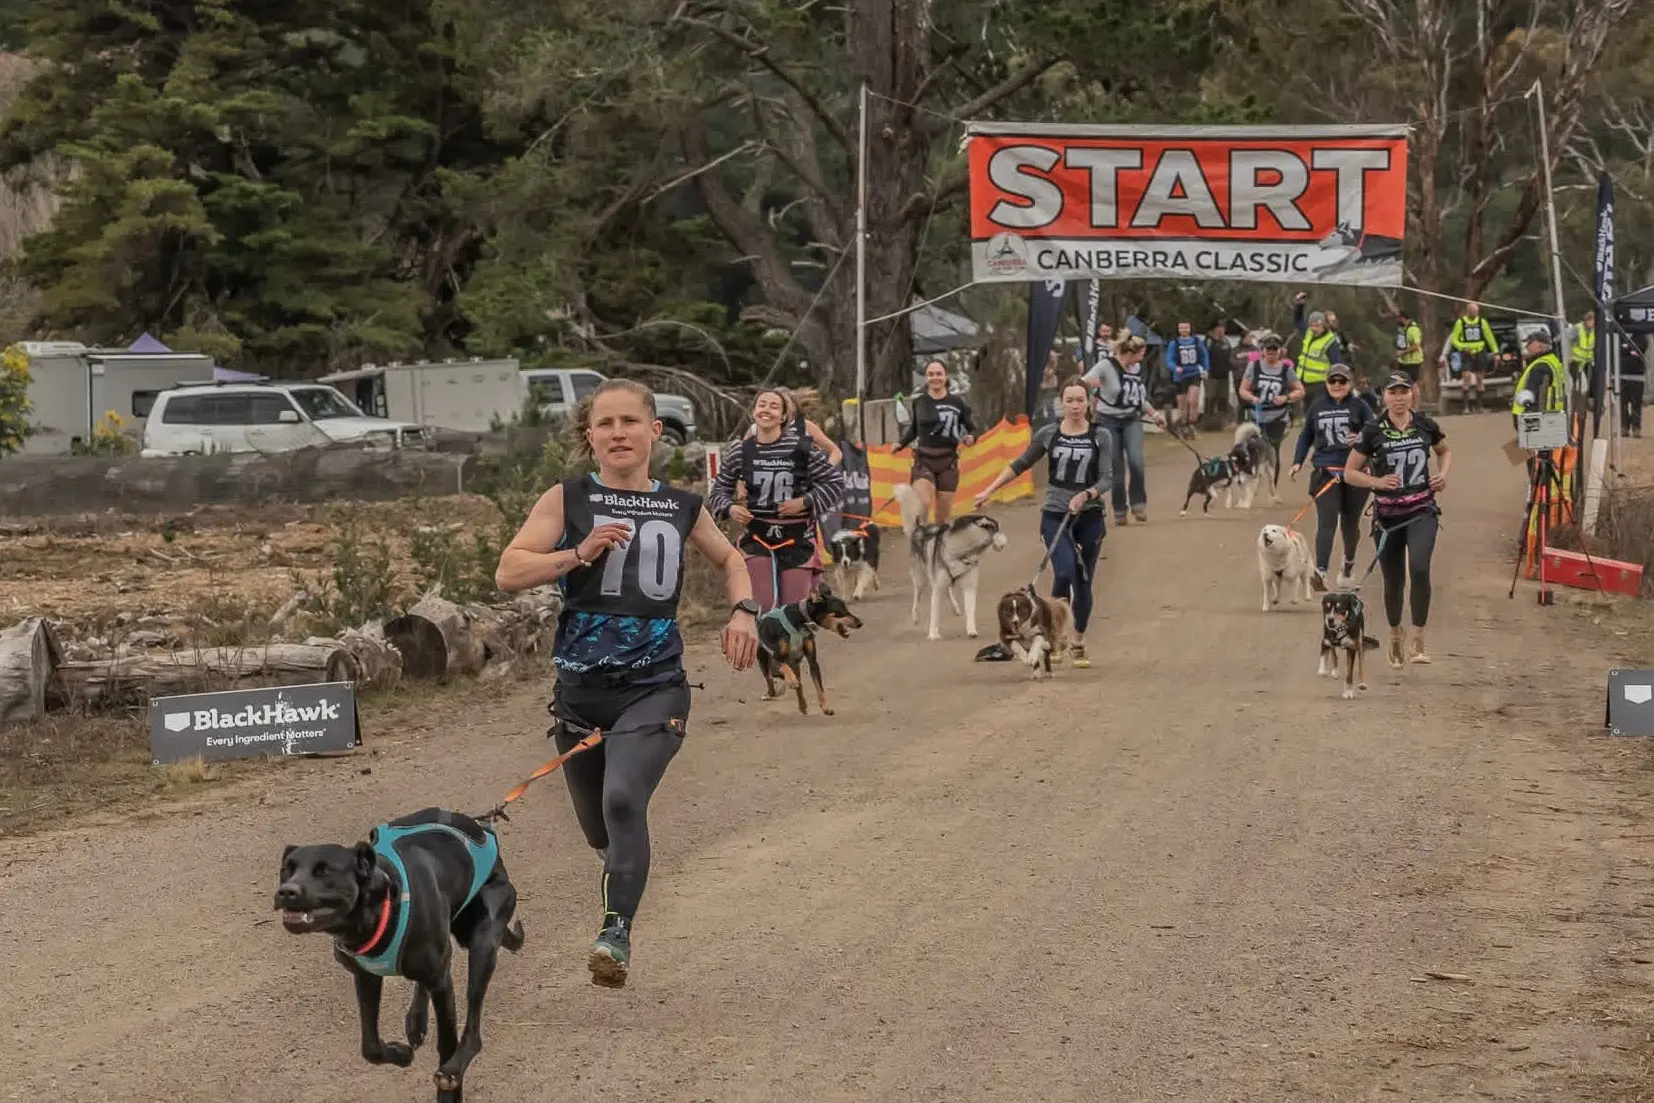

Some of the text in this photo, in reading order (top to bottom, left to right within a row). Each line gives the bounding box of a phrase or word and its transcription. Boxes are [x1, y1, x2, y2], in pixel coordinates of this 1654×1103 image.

[988, 144, 1391, 231] START
[1038, 249, 1309, 273] CANBERRA CLASSIC
[1318, 416, 1349, 446] 75
[1052, 446, 1092, 484] 77
[1387, 448, 1426, 488] 72
[604, 494, 679, 509] BlackHawk
[753, 471, 794, 506] 76
[593, 514, 680, 600] 70
[194, 699, 340, 732] BlackHawk
[206, 730, 325, 747] Every Ingredient Matters
